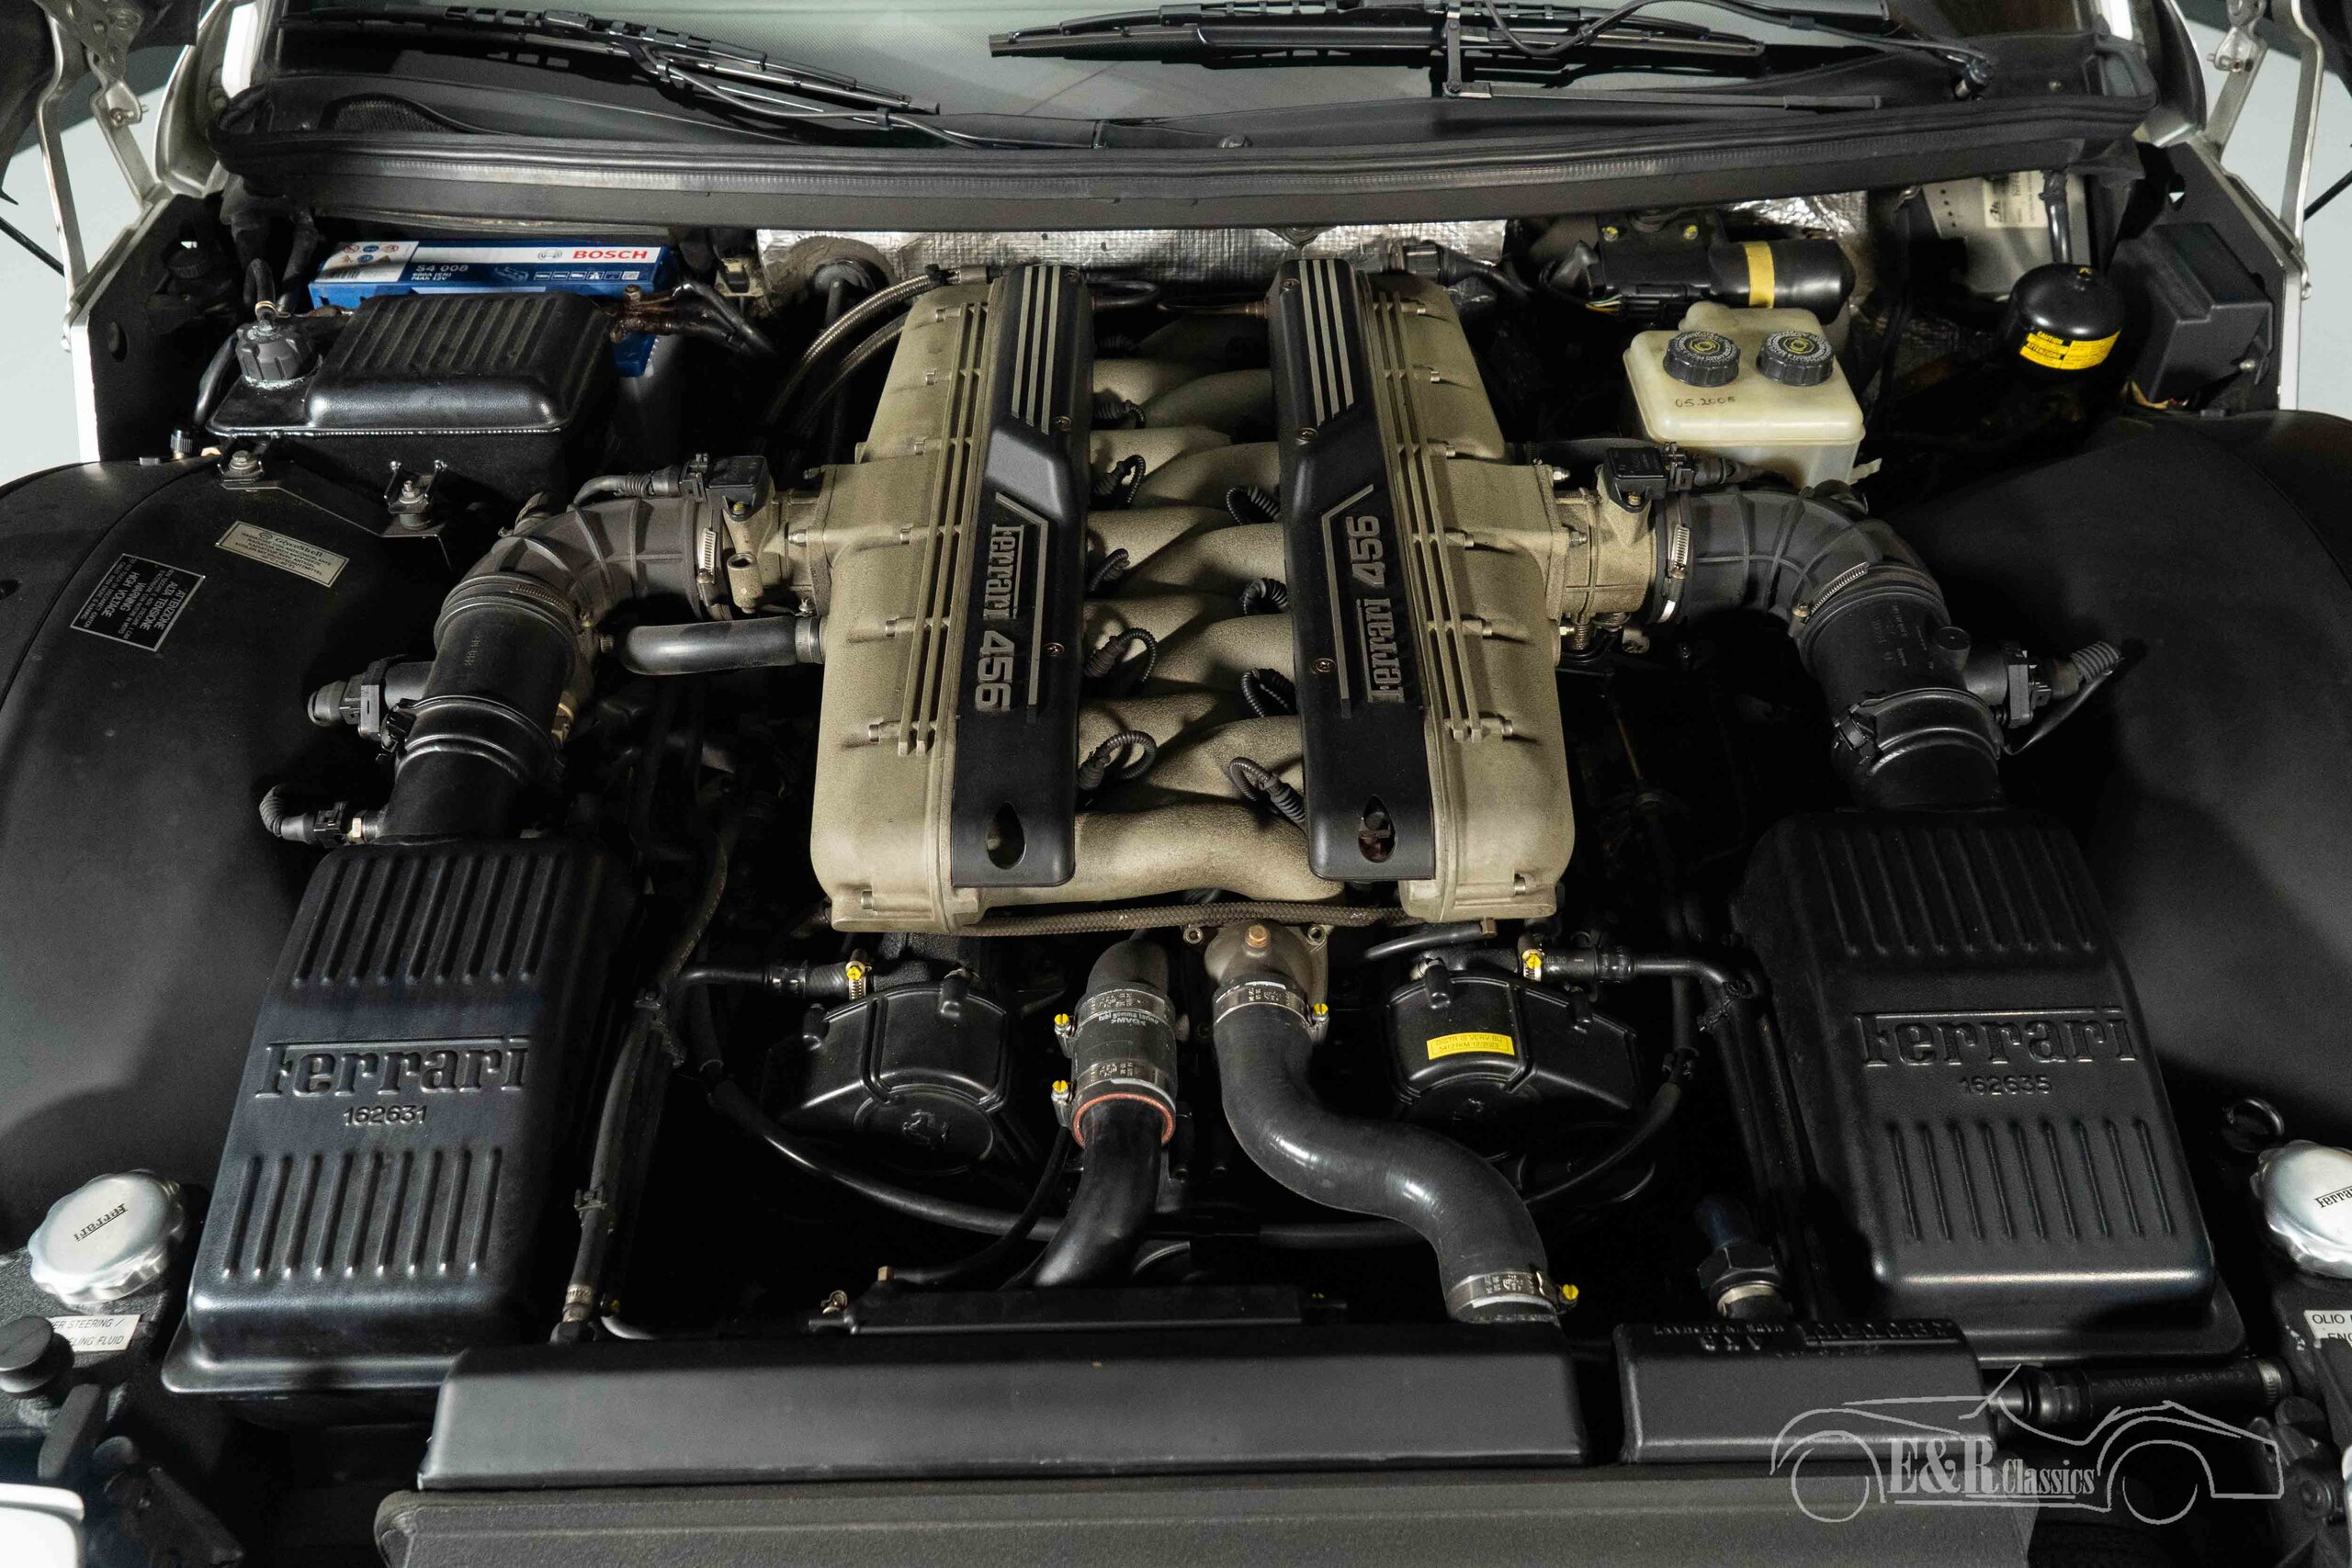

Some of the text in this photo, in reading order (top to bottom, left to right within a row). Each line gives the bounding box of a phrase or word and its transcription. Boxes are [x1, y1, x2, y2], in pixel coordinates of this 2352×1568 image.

[573, 250, 648, 259] BOSCH
[1346, 515, 1385, 589] 456
[100, 570, 140, 617] HIGH VOLTAGE
[119, 581, 147, 611] WARNING
[138, 581, 179, 630] ALTA TENSIONE
[975, 524, 1024, 712] Ferrari 456
[1356, 598, 1406, 704] Ferrari
[1854, 1007, 2137, 1067] Ferrari
[255, 1035, 530, 1099] Ferrari
[343, 1105, 427, 1126] 162631
[2314, 1185, 2352, 1208] Ferra
[74, 1203, 129, 1241] Ferrari
[68, 1318, 114, 1329] STEERING
[2312, 1314, 2346, 1325] OLIO
[96, 1335, 124, 1346] FLUID
